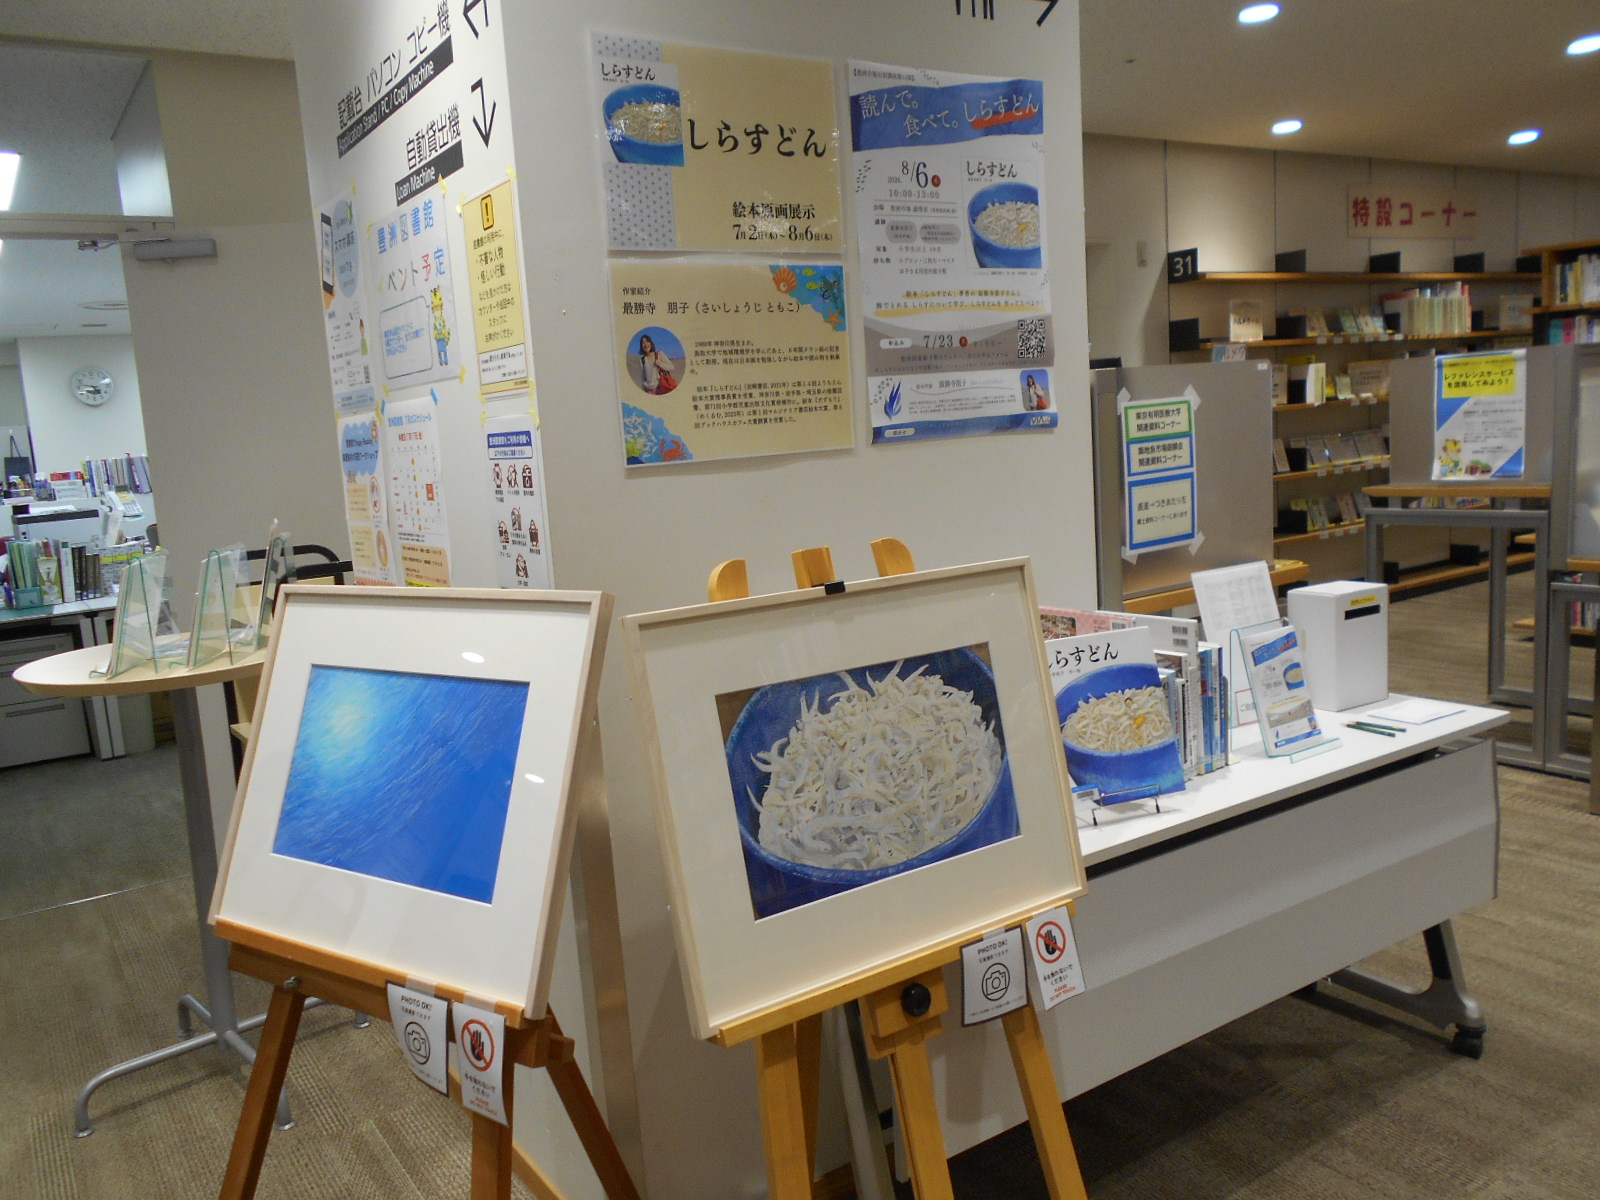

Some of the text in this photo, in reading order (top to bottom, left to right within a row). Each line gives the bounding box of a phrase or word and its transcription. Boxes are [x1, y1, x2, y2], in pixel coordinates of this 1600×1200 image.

[366, 49, 401, 103] パソコン
[407, 0, 451, 64] コピー機
[601, 62, 656, 81] しらすどん
[362, 107, 378, 133] Stand
[381, 96, 390, 117] PC
[393, 80, 409, 106] Copy
[408, 60, 435, 94] Machine
[859, 90, 919, 119] 読んで。
[963, 93, 1040, 122] しらすどん
[904, 110, 959, 138] 食べて。
[406, 102, 461, 170] 自動貸出機
[687, 117, 827, 158] しらすどん
[901, 160, 929, 189] 8/6
[966, 160, 1018, 178] しらすどん
[396, 164, 436, 201] Loan Machine
[733, 201, 816, 220] 絵本原画展示
[1352, 196, 1478, 228] 特設コーナー
[1172, 255, 1194, 278] 31
[622, 286, 652, 297] 作家紹介
[622, 302, 656, 316] 最勝寺
[923, 334, 954, 349] 7/23
[1443, 368, 1516, 381] レファレンスサービス
[1136, 421, 1182, 433] 関連資料コーナー
[1138, 455, 1183, 468] 関連資料コーナー
[1048, 642, 1119, 670] らすどん
[977, 942, 998, 956] PHOTO
[401, 995, 421, 1008] PHOTO
